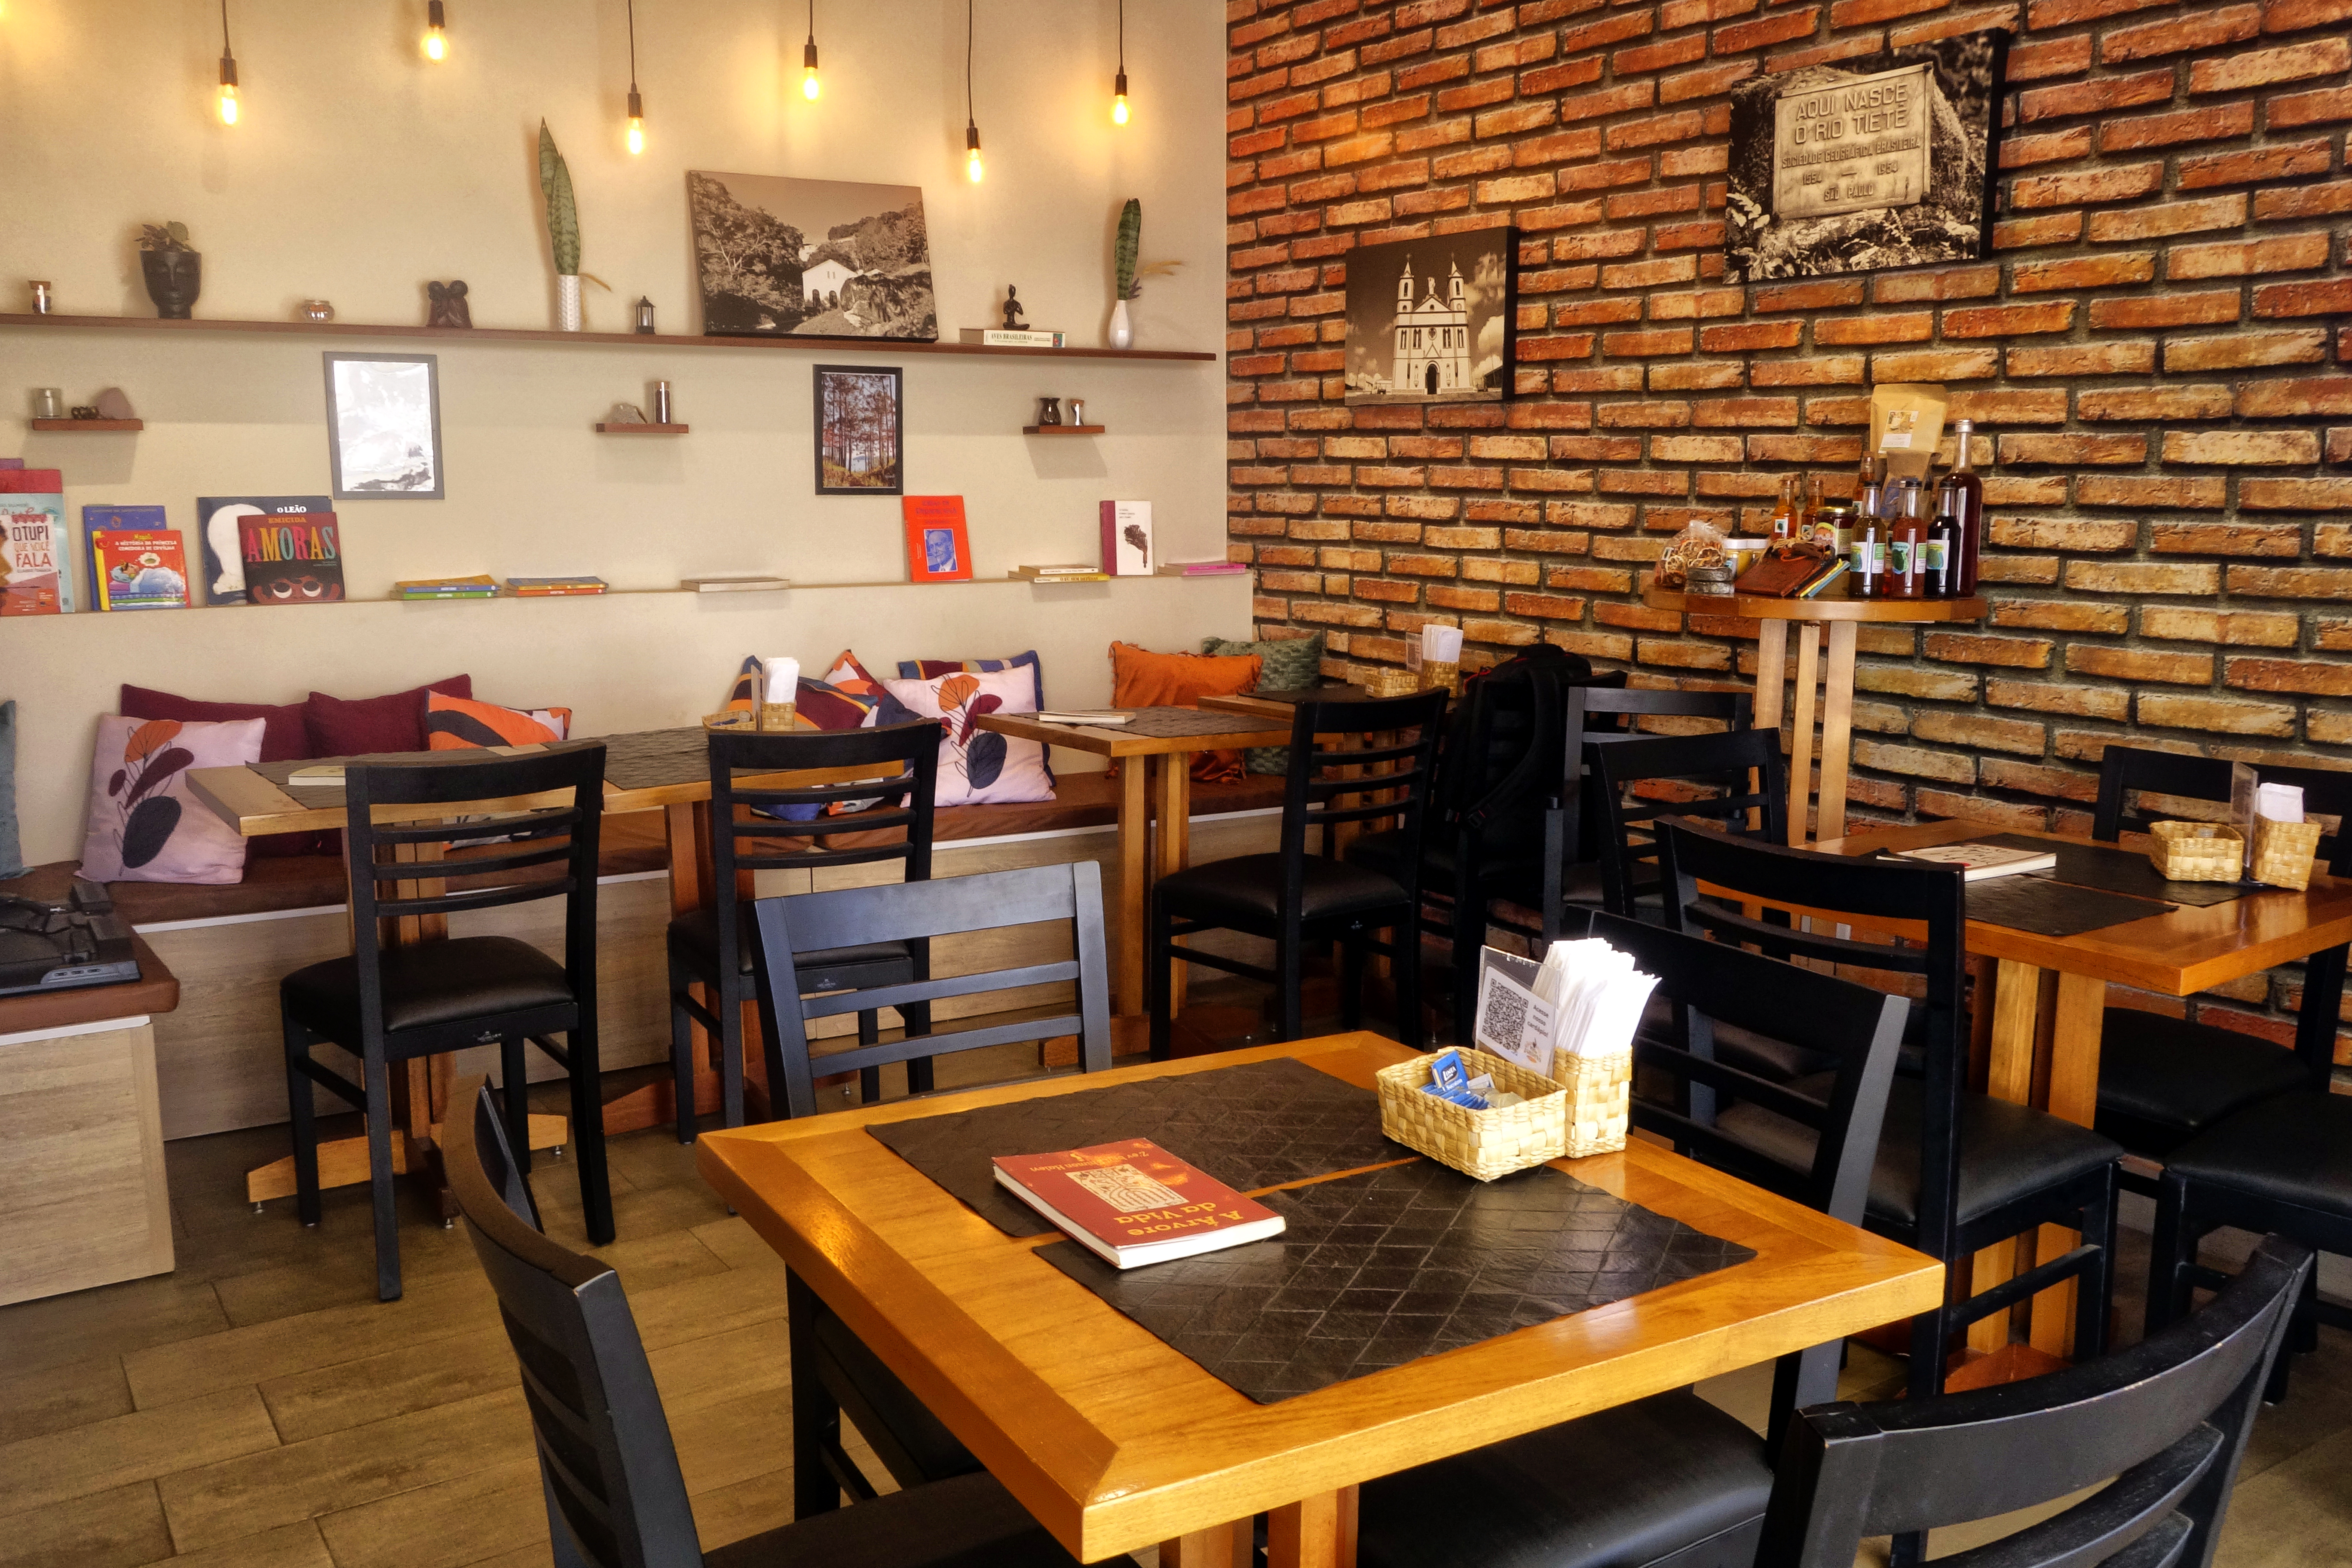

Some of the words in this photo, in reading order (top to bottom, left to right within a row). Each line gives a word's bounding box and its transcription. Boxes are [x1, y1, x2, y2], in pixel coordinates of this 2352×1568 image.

[1796, 95, 1835, 121] AQUI
[1845, 83, 1908, 112] NASCE
[1795, 126, 1807, 144] O
[1815, 119, 1843, 141] RIO
[1853, 103, 1908, 135] TIETÊ
[1782, 152, 1822, 168] SOCIEDADE
[1875, 136, 1921, 154] BRASILEIRA
[1803, 172, 1822, 185] 1554
[1877, 162, 1899, 175] 1954
[1847, 184, 1874, 199] PAULO
[284, 504, 307, 513] LEÃO
[247, 526, 337, 563] AMORAS
[15, 552, 52, 568] FALA
[1442, 1066, 1457, 1081] LINEA
[1179, 1202, 1217, 1213] da
[1218, 1210, 1244, 1221] A
[1113, 1210, 1183, 1224] Vida
[1127, 1215, 1219, 1236] Árvore
